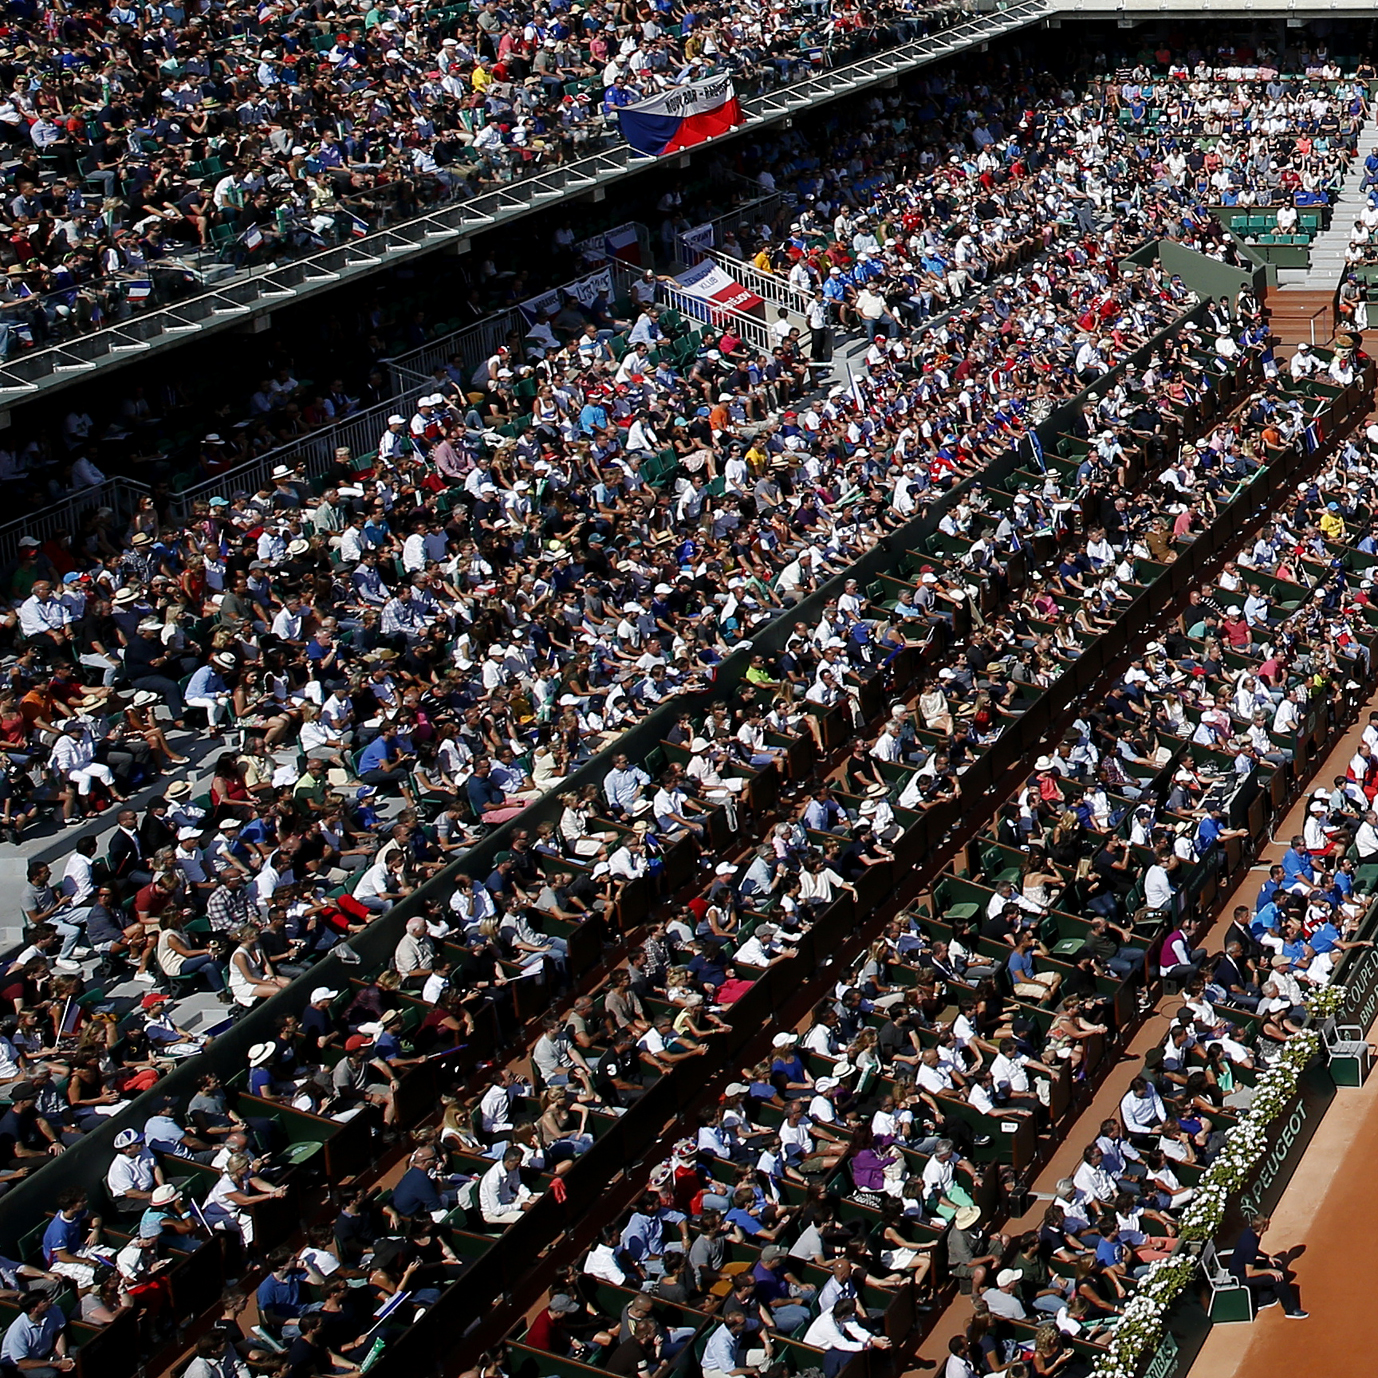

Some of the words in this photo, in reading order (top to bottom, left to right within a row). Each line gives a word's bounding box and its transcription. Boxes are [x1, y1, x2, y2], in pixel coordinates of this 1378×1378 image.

[698, 276, 718, 290] KLUB
[1346, 960, 1375, 1013] COUPE
[1360, 995, 1377, 1025] BNP
[1252, 1098, 1307, 1204] PEUGEOT
